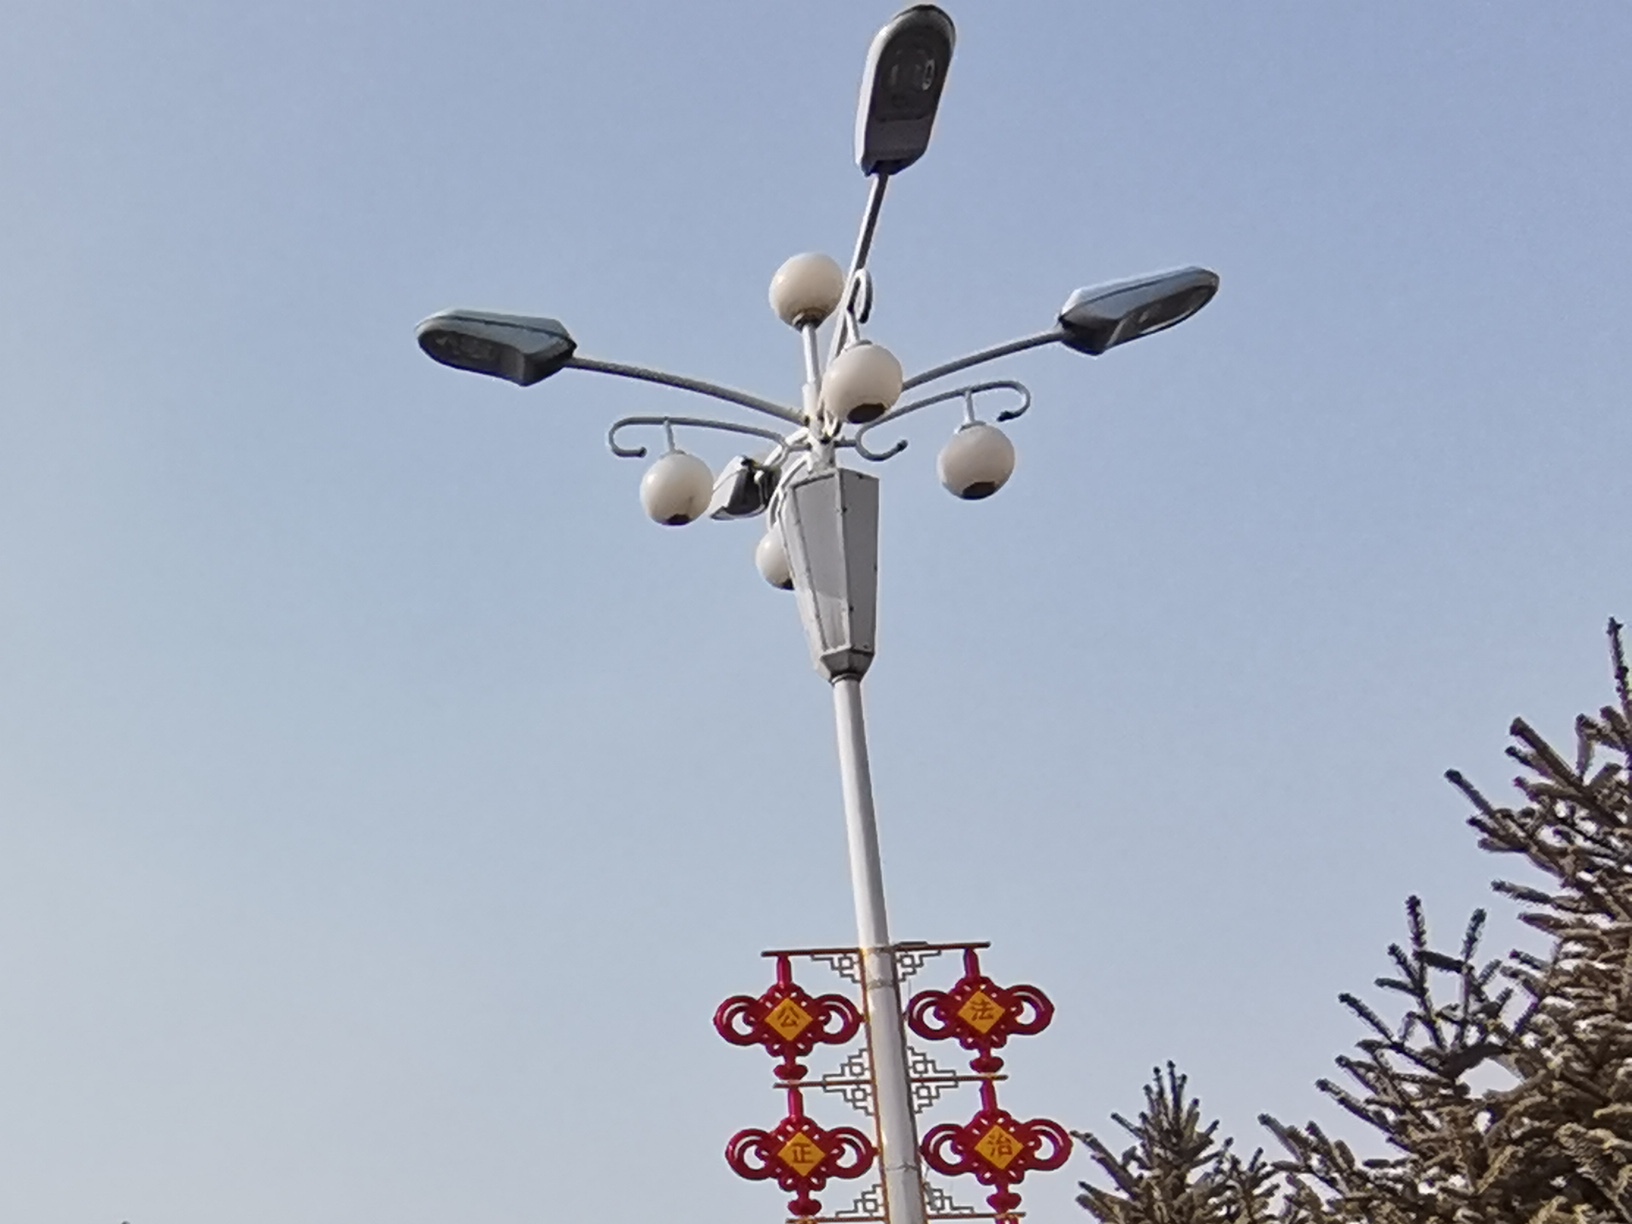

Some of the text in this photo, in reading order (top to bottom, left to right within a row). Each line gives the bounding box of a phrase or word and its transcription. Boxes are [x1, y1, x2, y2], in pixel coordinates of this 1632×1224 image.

[777, 1005, 800, 1029] 公
[970, 999, 994, 1022] 法
[791, 1142, 814, 1165] 正
